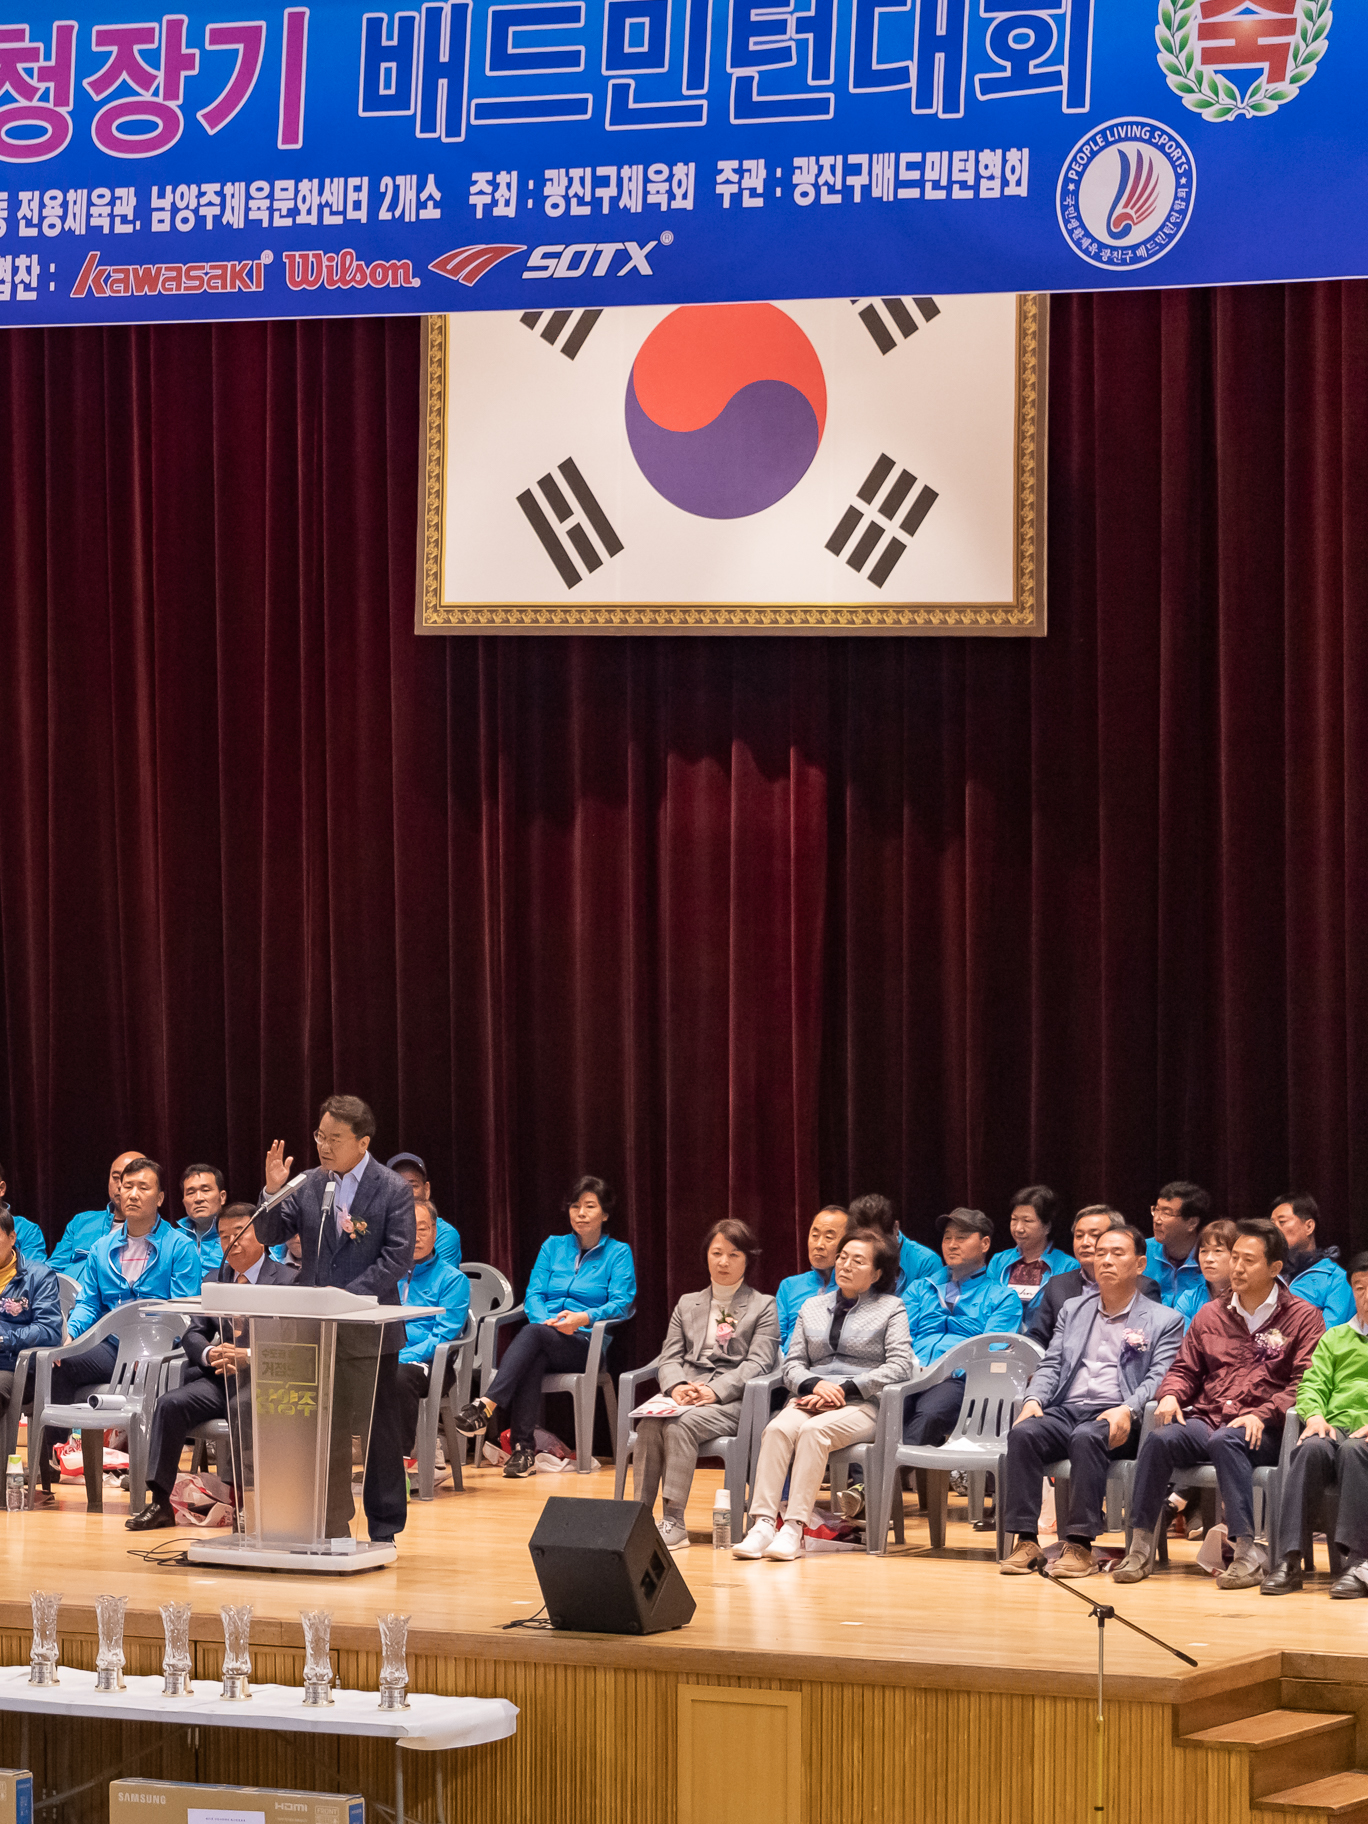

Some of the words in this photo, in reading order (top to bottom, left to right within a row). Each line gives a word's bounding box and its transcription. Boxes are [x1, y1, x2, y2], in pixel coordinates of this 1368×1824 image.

[1196, 0, 1298, 86] 축
[358, 0, 1095, 142] 배드민턴대회
[1067, 133, 1106, 180] PEOPLE
[1106, 124, 1151, 142] LIVING
[1151, 130, 1189, 174] SPORTS
[150, 175, 369, 234] 남양주체육문화센터
[378, 173, 442, 223] 2개소
[468, 170, 518, 219] 주최
[543, 161, 695, 218] 광진구체육회
[715, 158, 766, 209] 주관
[792, 148, 1029, 207] 광진구배드민턴협회
[522, 240, 659, 280] SOTX
[1099, 248, 1134, 263] 광진구
[118, 1792, 166, 1804] SAMSUNG
[274, 1801, 308, 1812] HDMI
